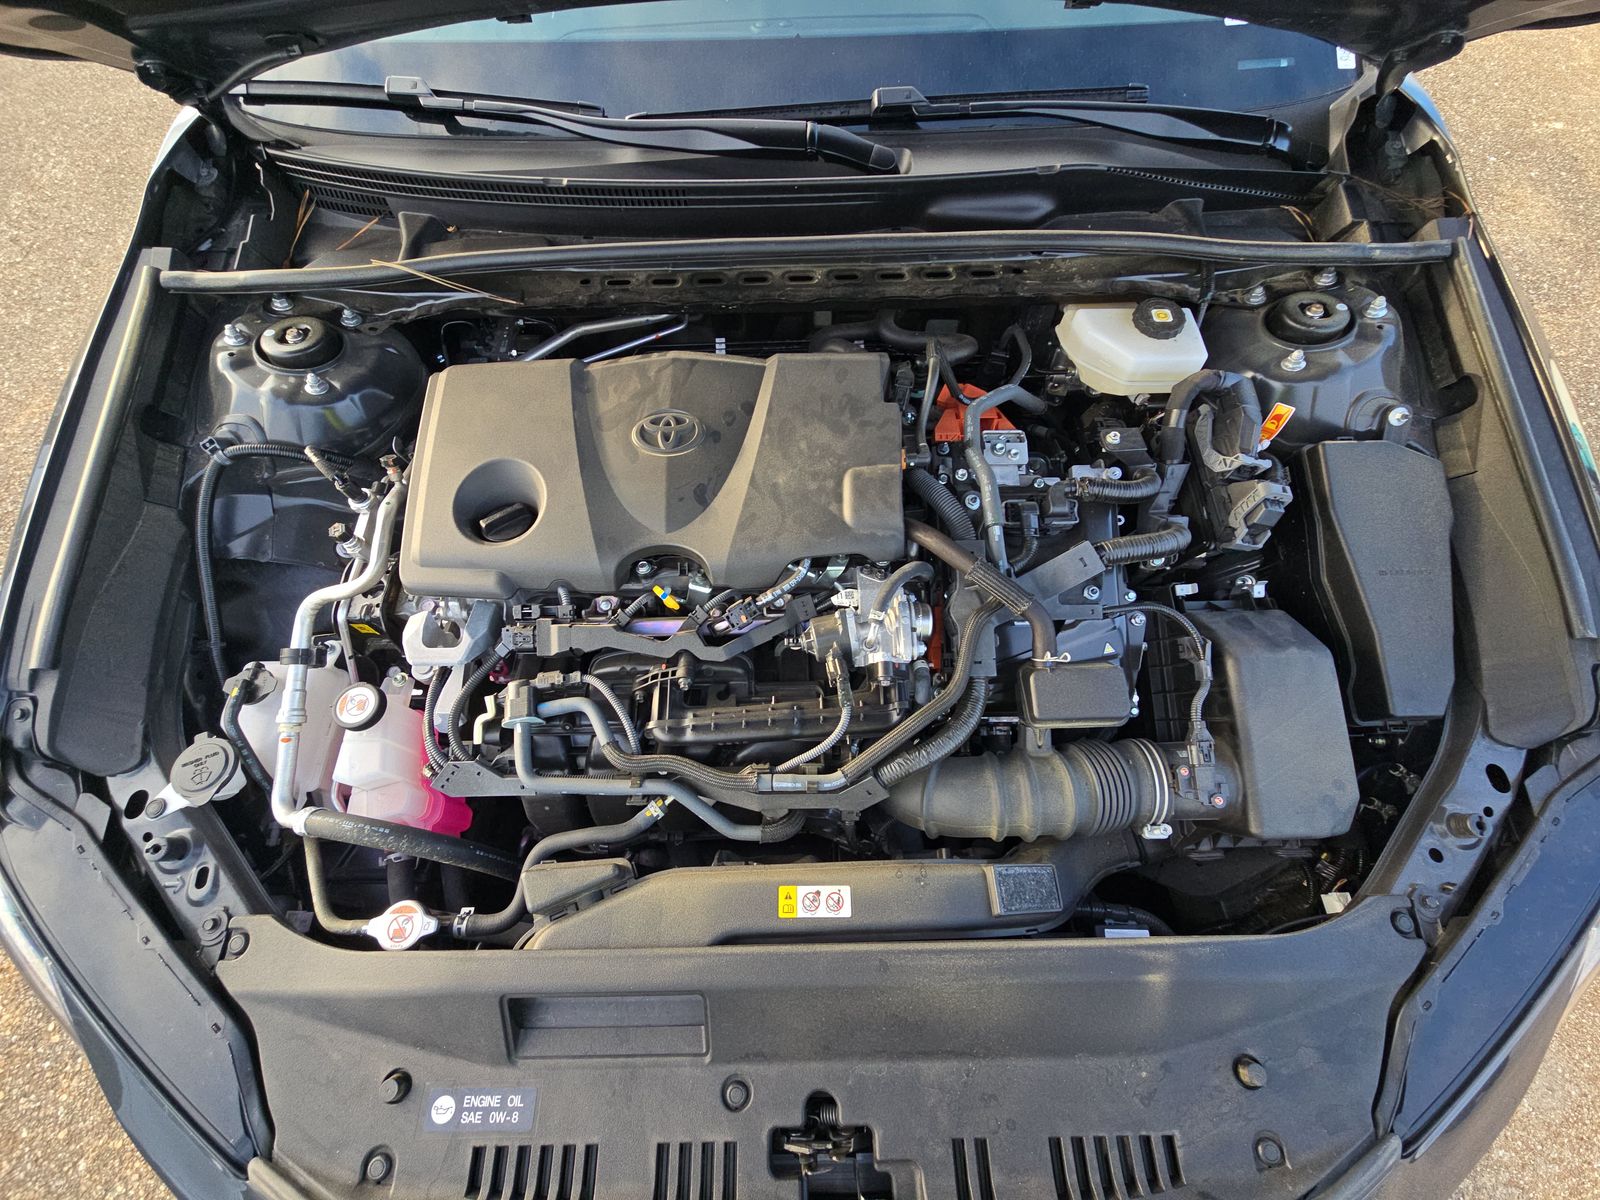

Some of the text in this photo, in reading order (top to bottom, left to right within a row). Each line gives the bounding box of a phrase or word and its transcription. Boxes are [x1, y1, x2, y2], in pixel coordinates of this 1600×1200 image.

[463, 1095, 524, 1108] ENGINE OIL
[460, 1111, 519, 1124] SAE 0W-8
